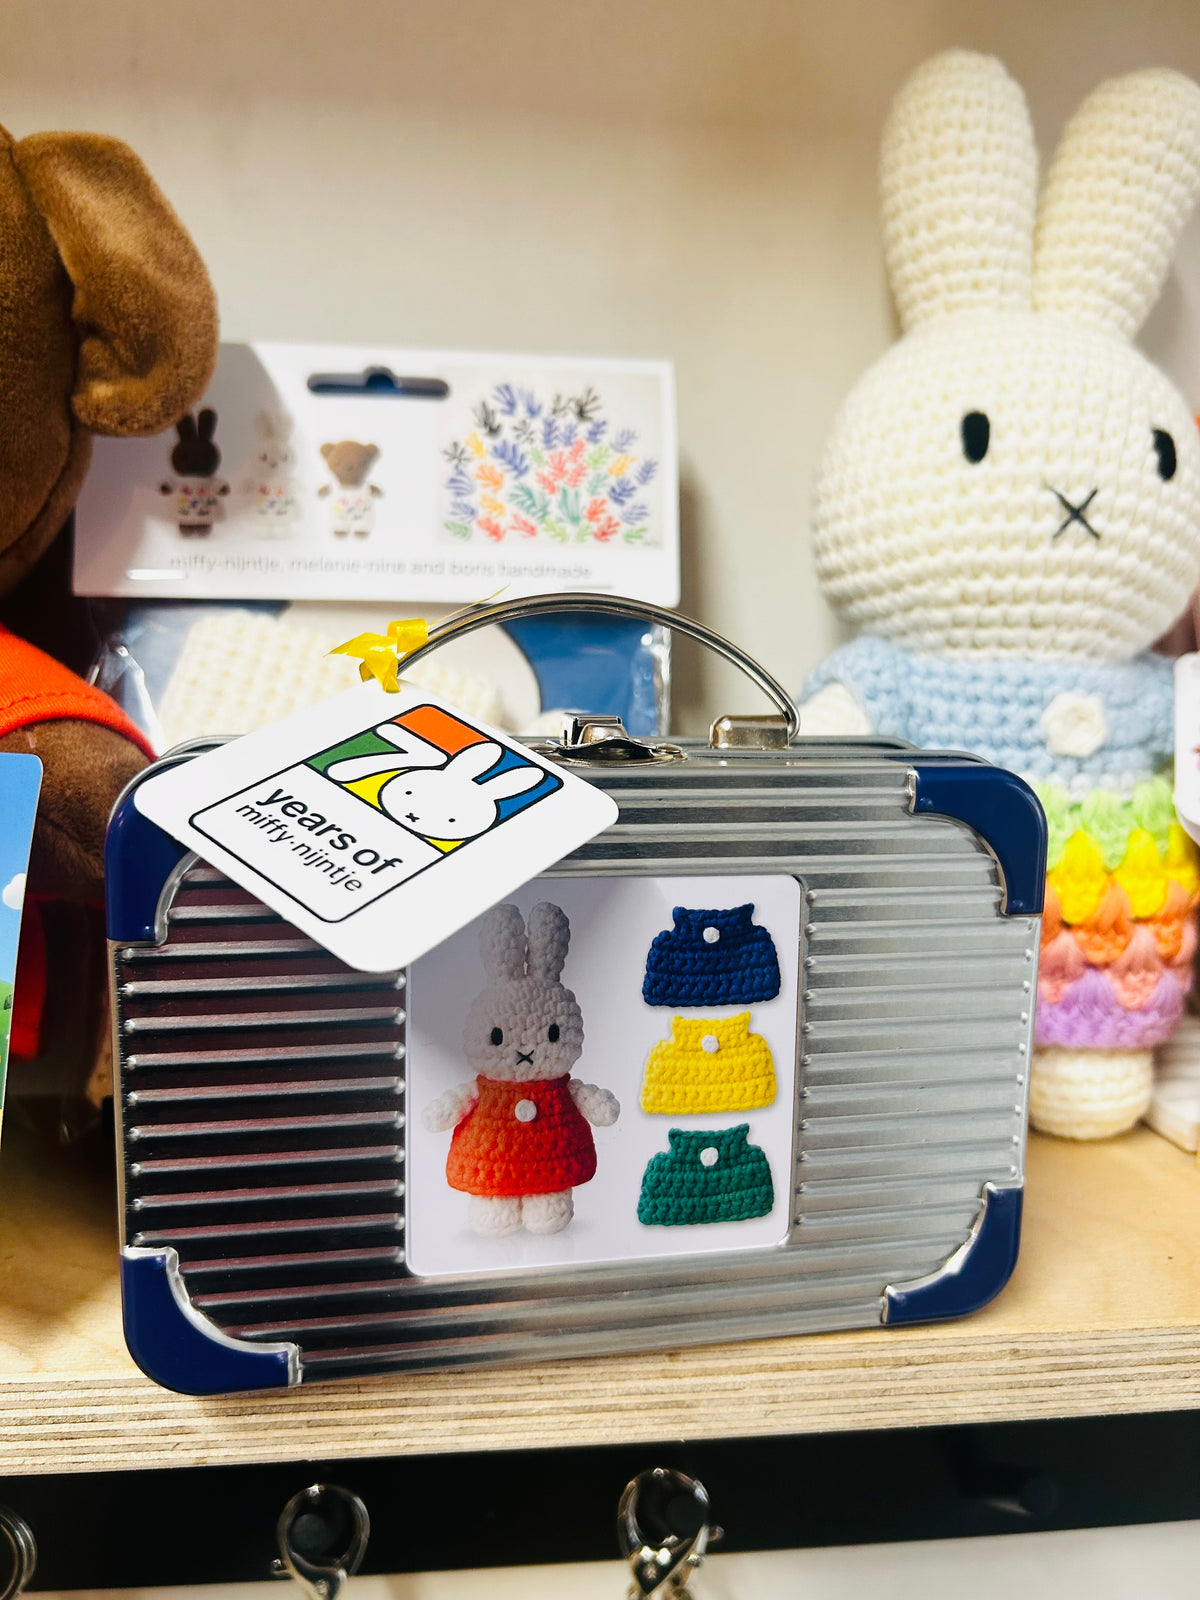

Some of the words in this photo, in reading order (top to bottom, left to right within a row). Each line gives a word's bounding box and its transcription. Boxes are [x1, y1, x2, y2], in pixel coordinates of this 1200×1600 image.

[409, 560, 446, 574] and
[498, 561, 593, 578] handmade
[255, 788, 357, 851] years
[352, 848, 403, 875] of
